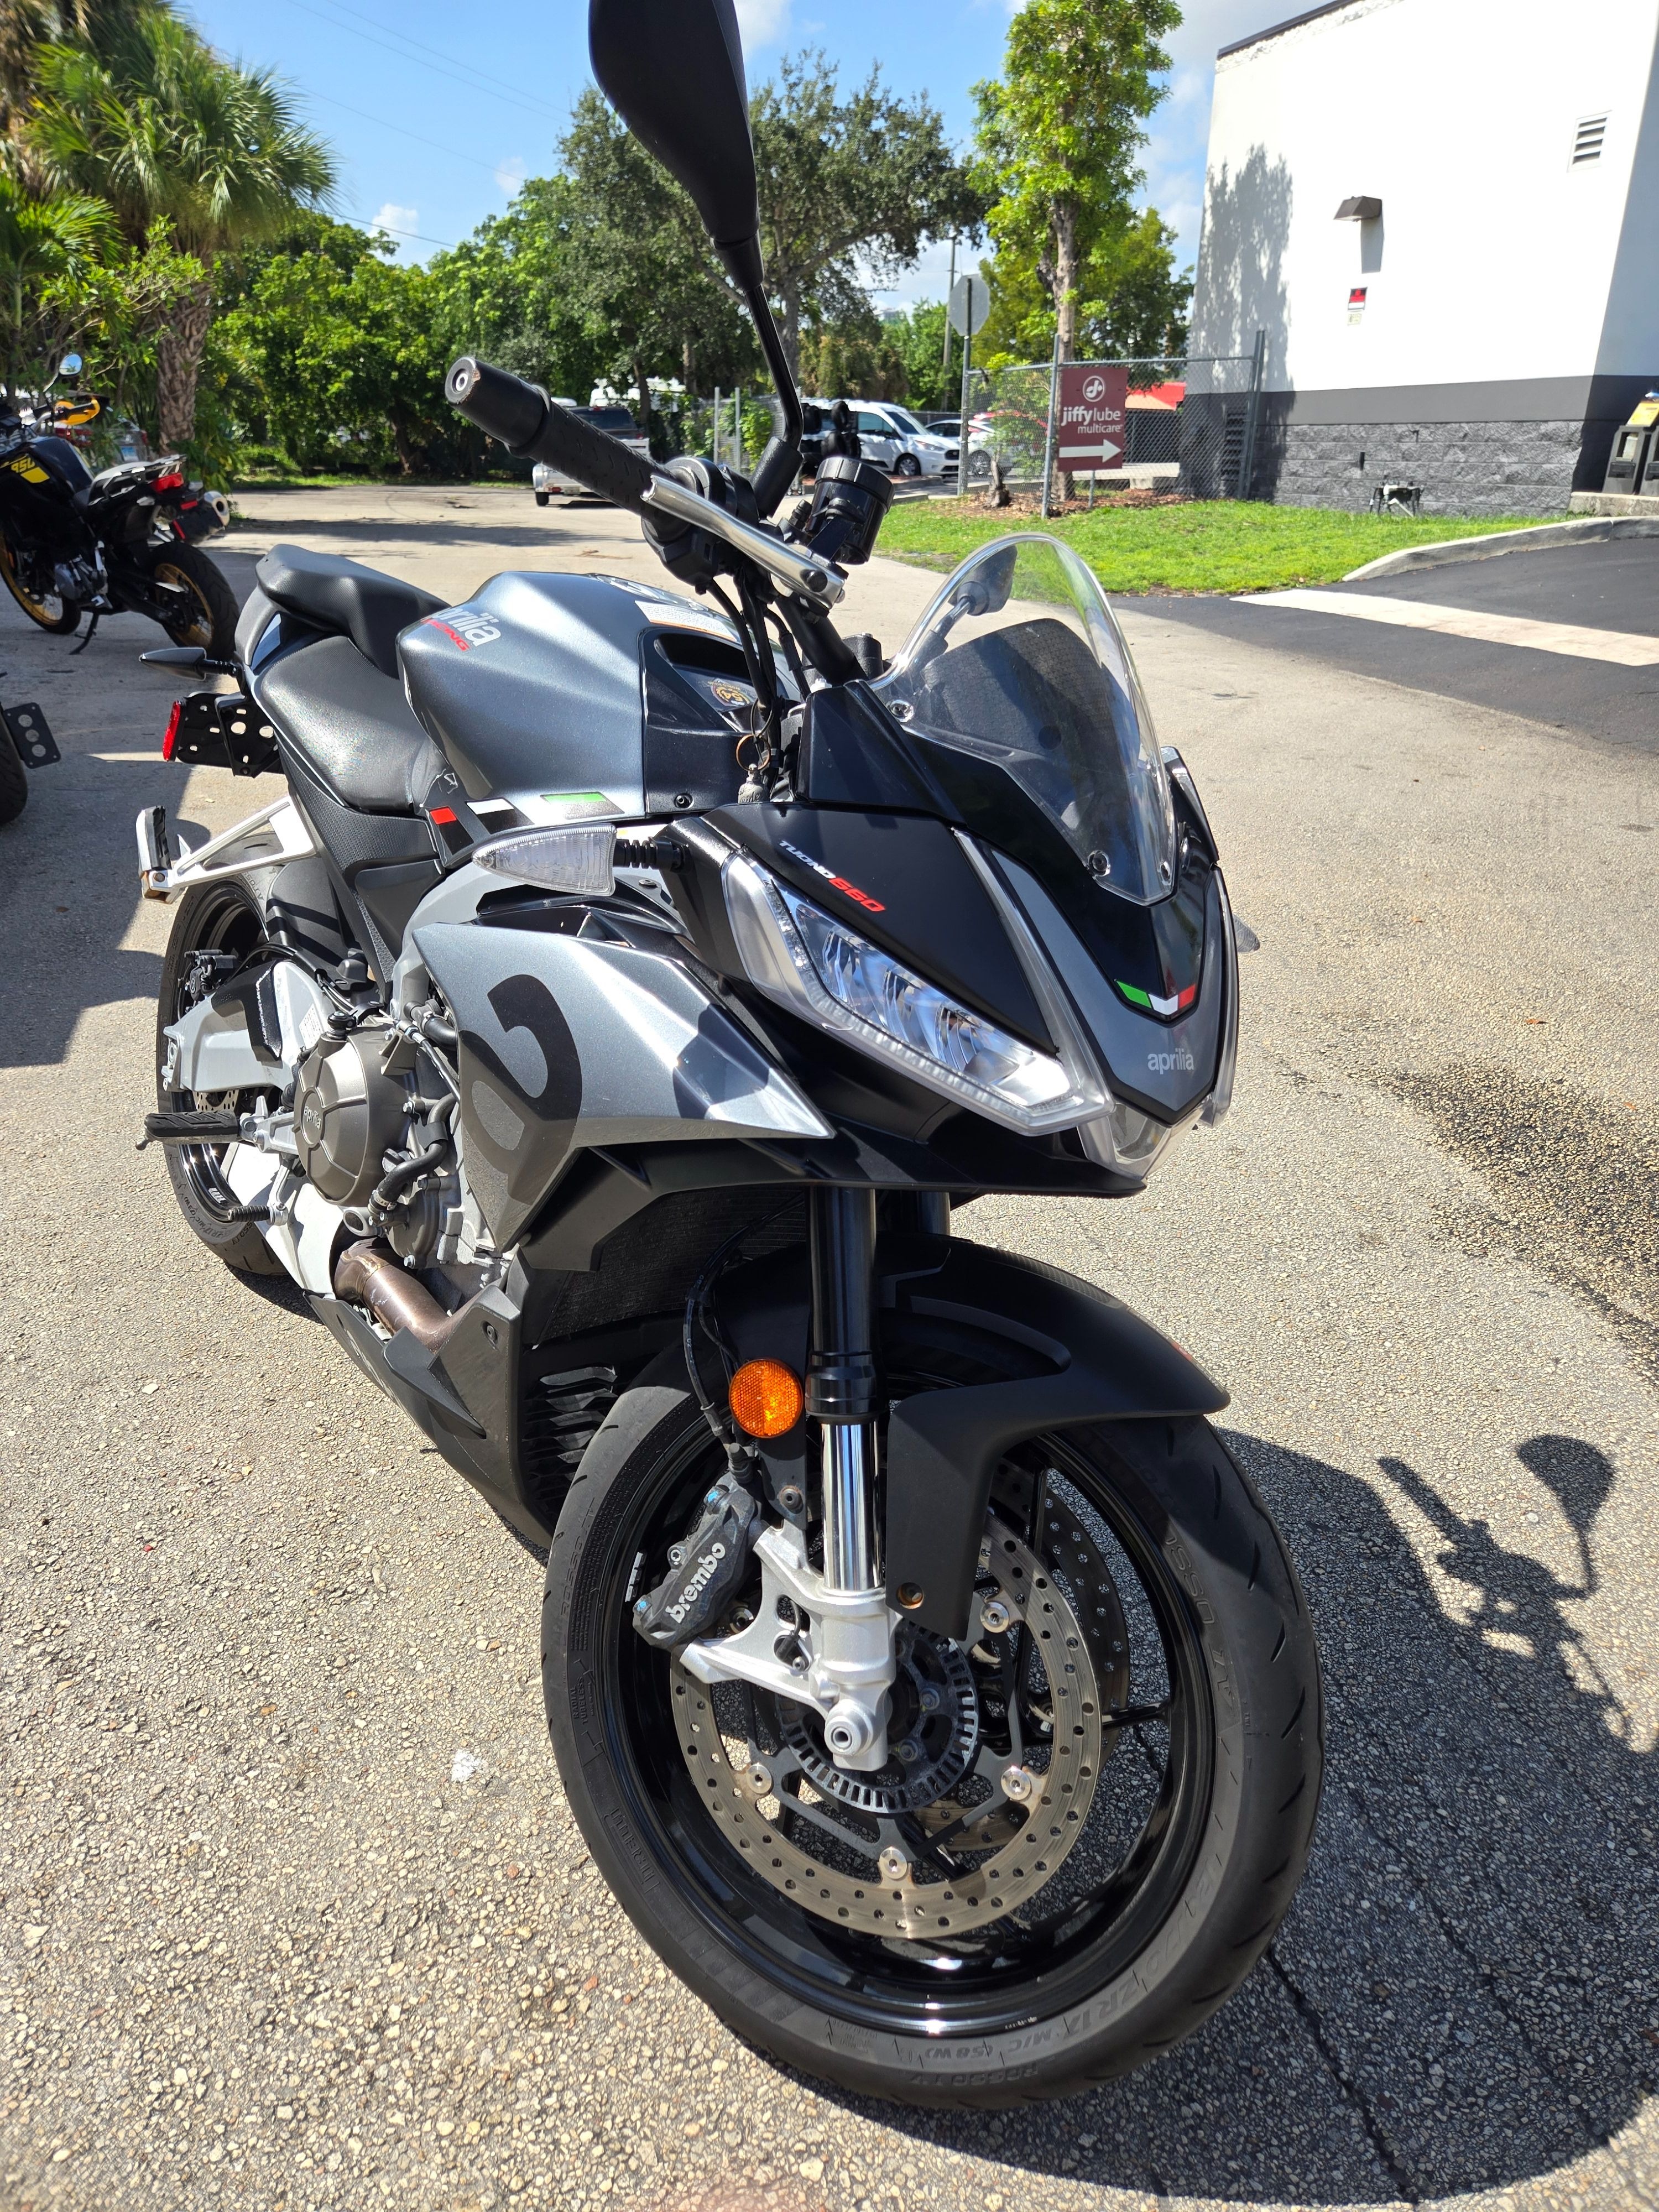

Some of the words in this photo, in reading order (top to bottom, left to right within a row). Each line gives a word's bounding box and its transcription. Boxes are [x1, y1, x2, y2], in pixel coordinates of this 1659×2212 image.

[1061, 406, 1093, 426] jiffy
[1093, 407, 1121, 421] lube
[1077, 424, 1121, 434] multicare
[779, 840, 836, 879] TUONO
[828, 877, 885, 911] 660
[1147, 1048, 1194, 1074] aprilia
[304, 1105, 321, 1130] aprilia
[665, 1542, 726, 1624] brembo
[570, 1686, 579, 1720] RADIAL
[577, 1676, 588, 1725] TUBELESS
